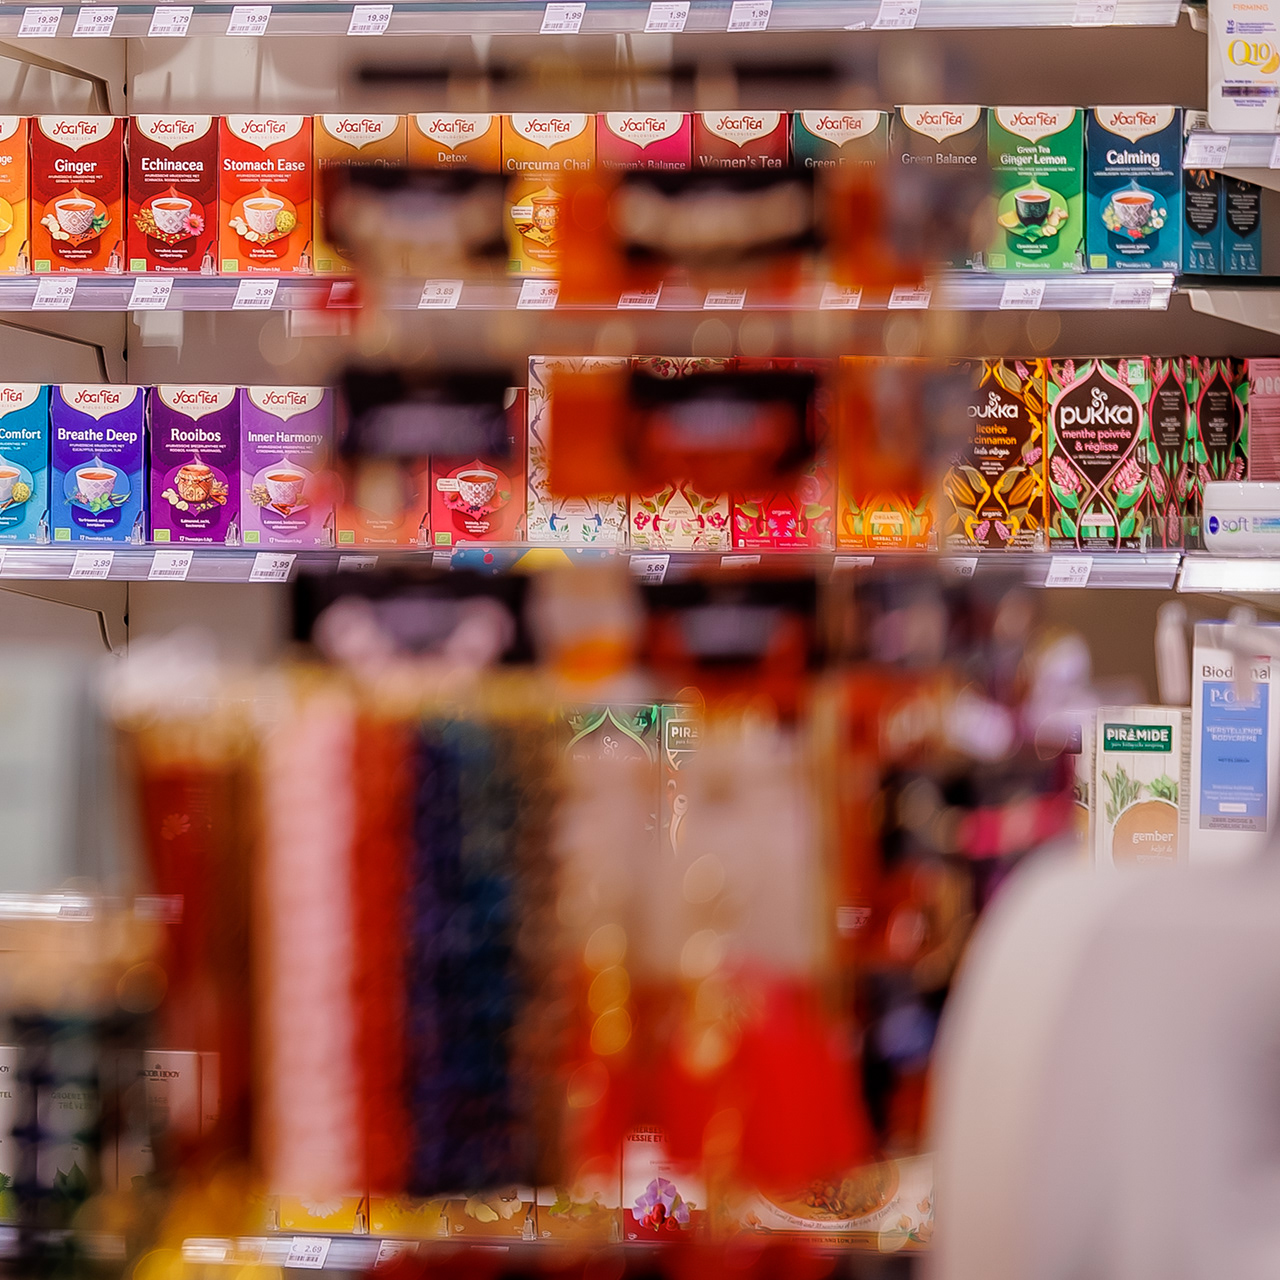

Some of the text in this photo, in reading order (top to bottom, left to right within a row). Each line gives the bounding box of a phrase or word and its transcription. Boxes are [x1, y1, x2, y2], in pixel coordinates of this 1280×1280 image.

[1228, 39, 1271, 66] Q10
[141, 158, 203, 171] Echinacea
[223, 159, 305, 172] Stomach Ease
[506, 158, 590, 171] Curcuma Chai
[1001, 154, 1067, 166] Ginger Lemon
[1106, 150, 1160, 167] Calming
[54, 159, 97, 173] Ginger
[1060, 387, 1132, 428] pukka
[58, 428, 137, 444] Breathe Deep
[171, 429, 221, 441] Rooibos
[248, 431, 323, 446] Inner Harmony
[1062, 427, 1131, 441] menthe poivrée
[1075, 440, 1118, 454] & réglisse
[1107, 729, 1169, 742] PIRAMIDE
[1132, 830, 1173, 844] gember
